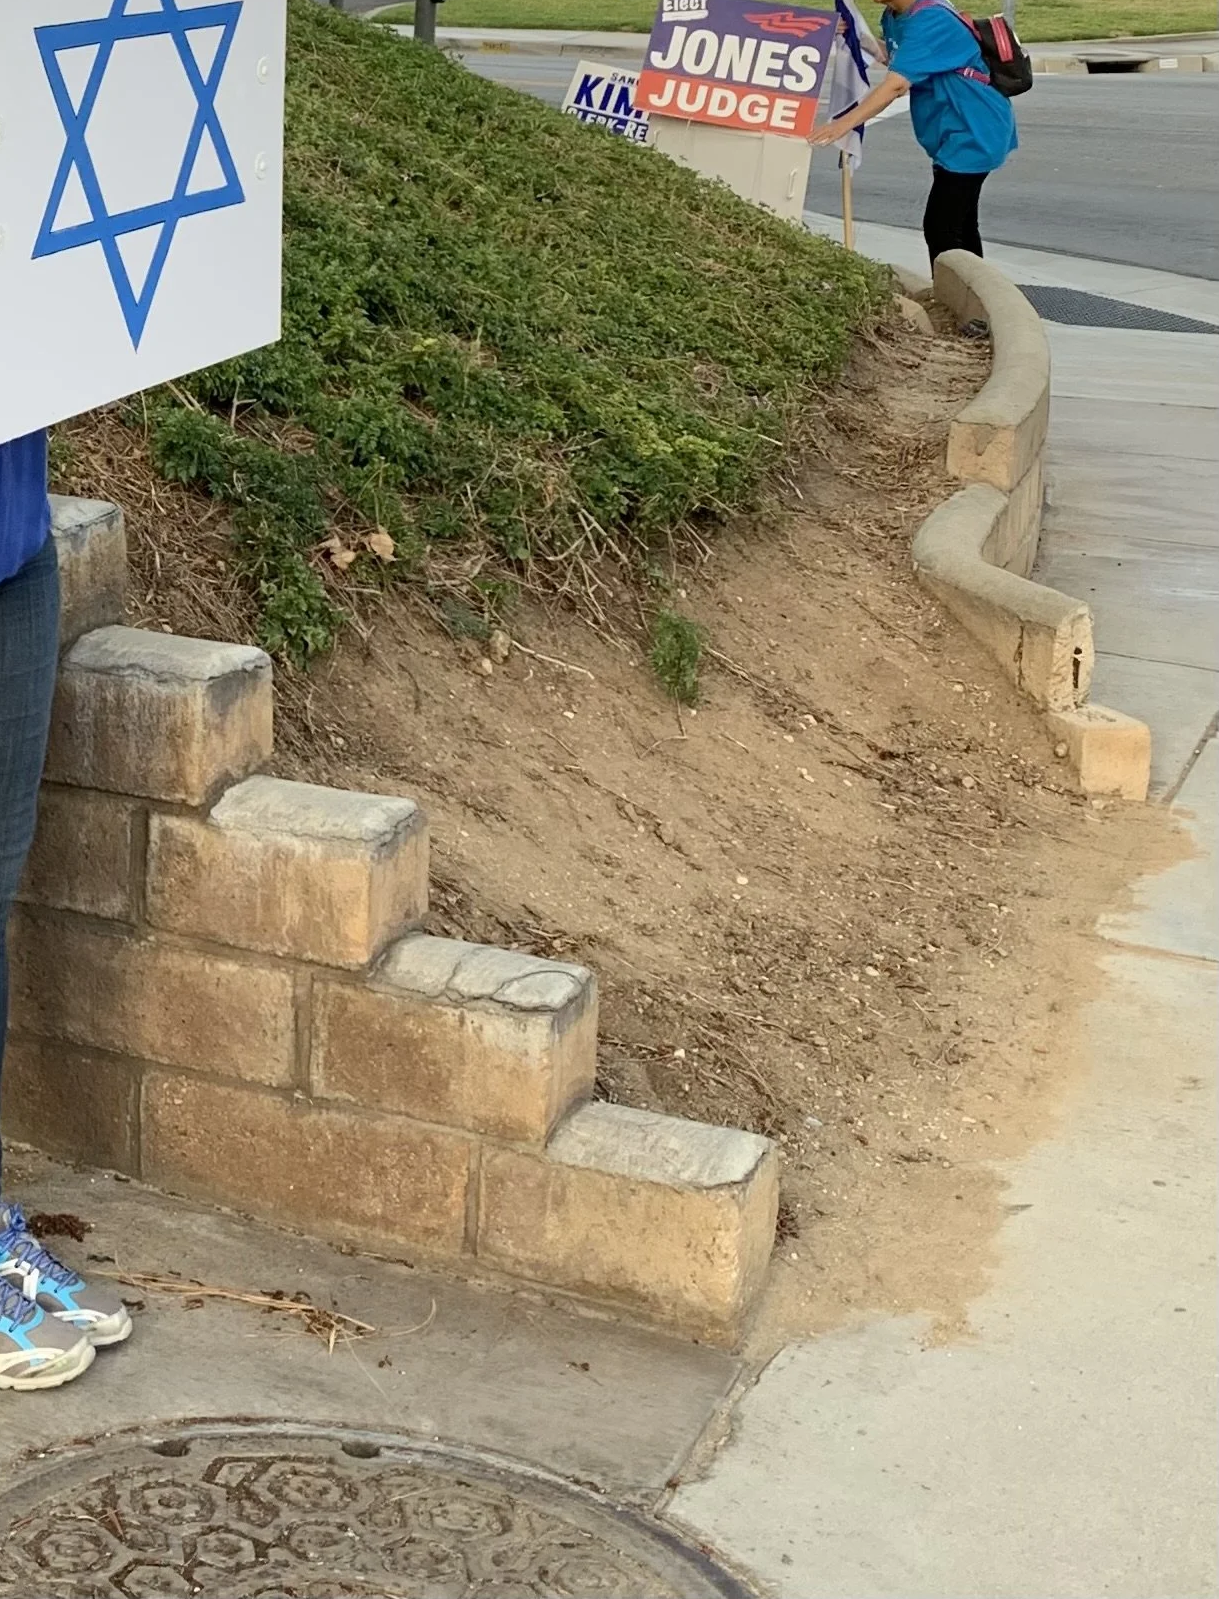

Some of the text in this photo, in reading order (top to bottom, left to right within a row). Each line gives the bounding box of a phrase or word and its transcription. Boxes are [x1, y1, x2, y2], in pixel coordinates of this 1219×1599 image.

[610, 72, 639, 87] SAN
[650, 26, 821, 92] JONES
[648, 79, 800, 130] JUDGE
